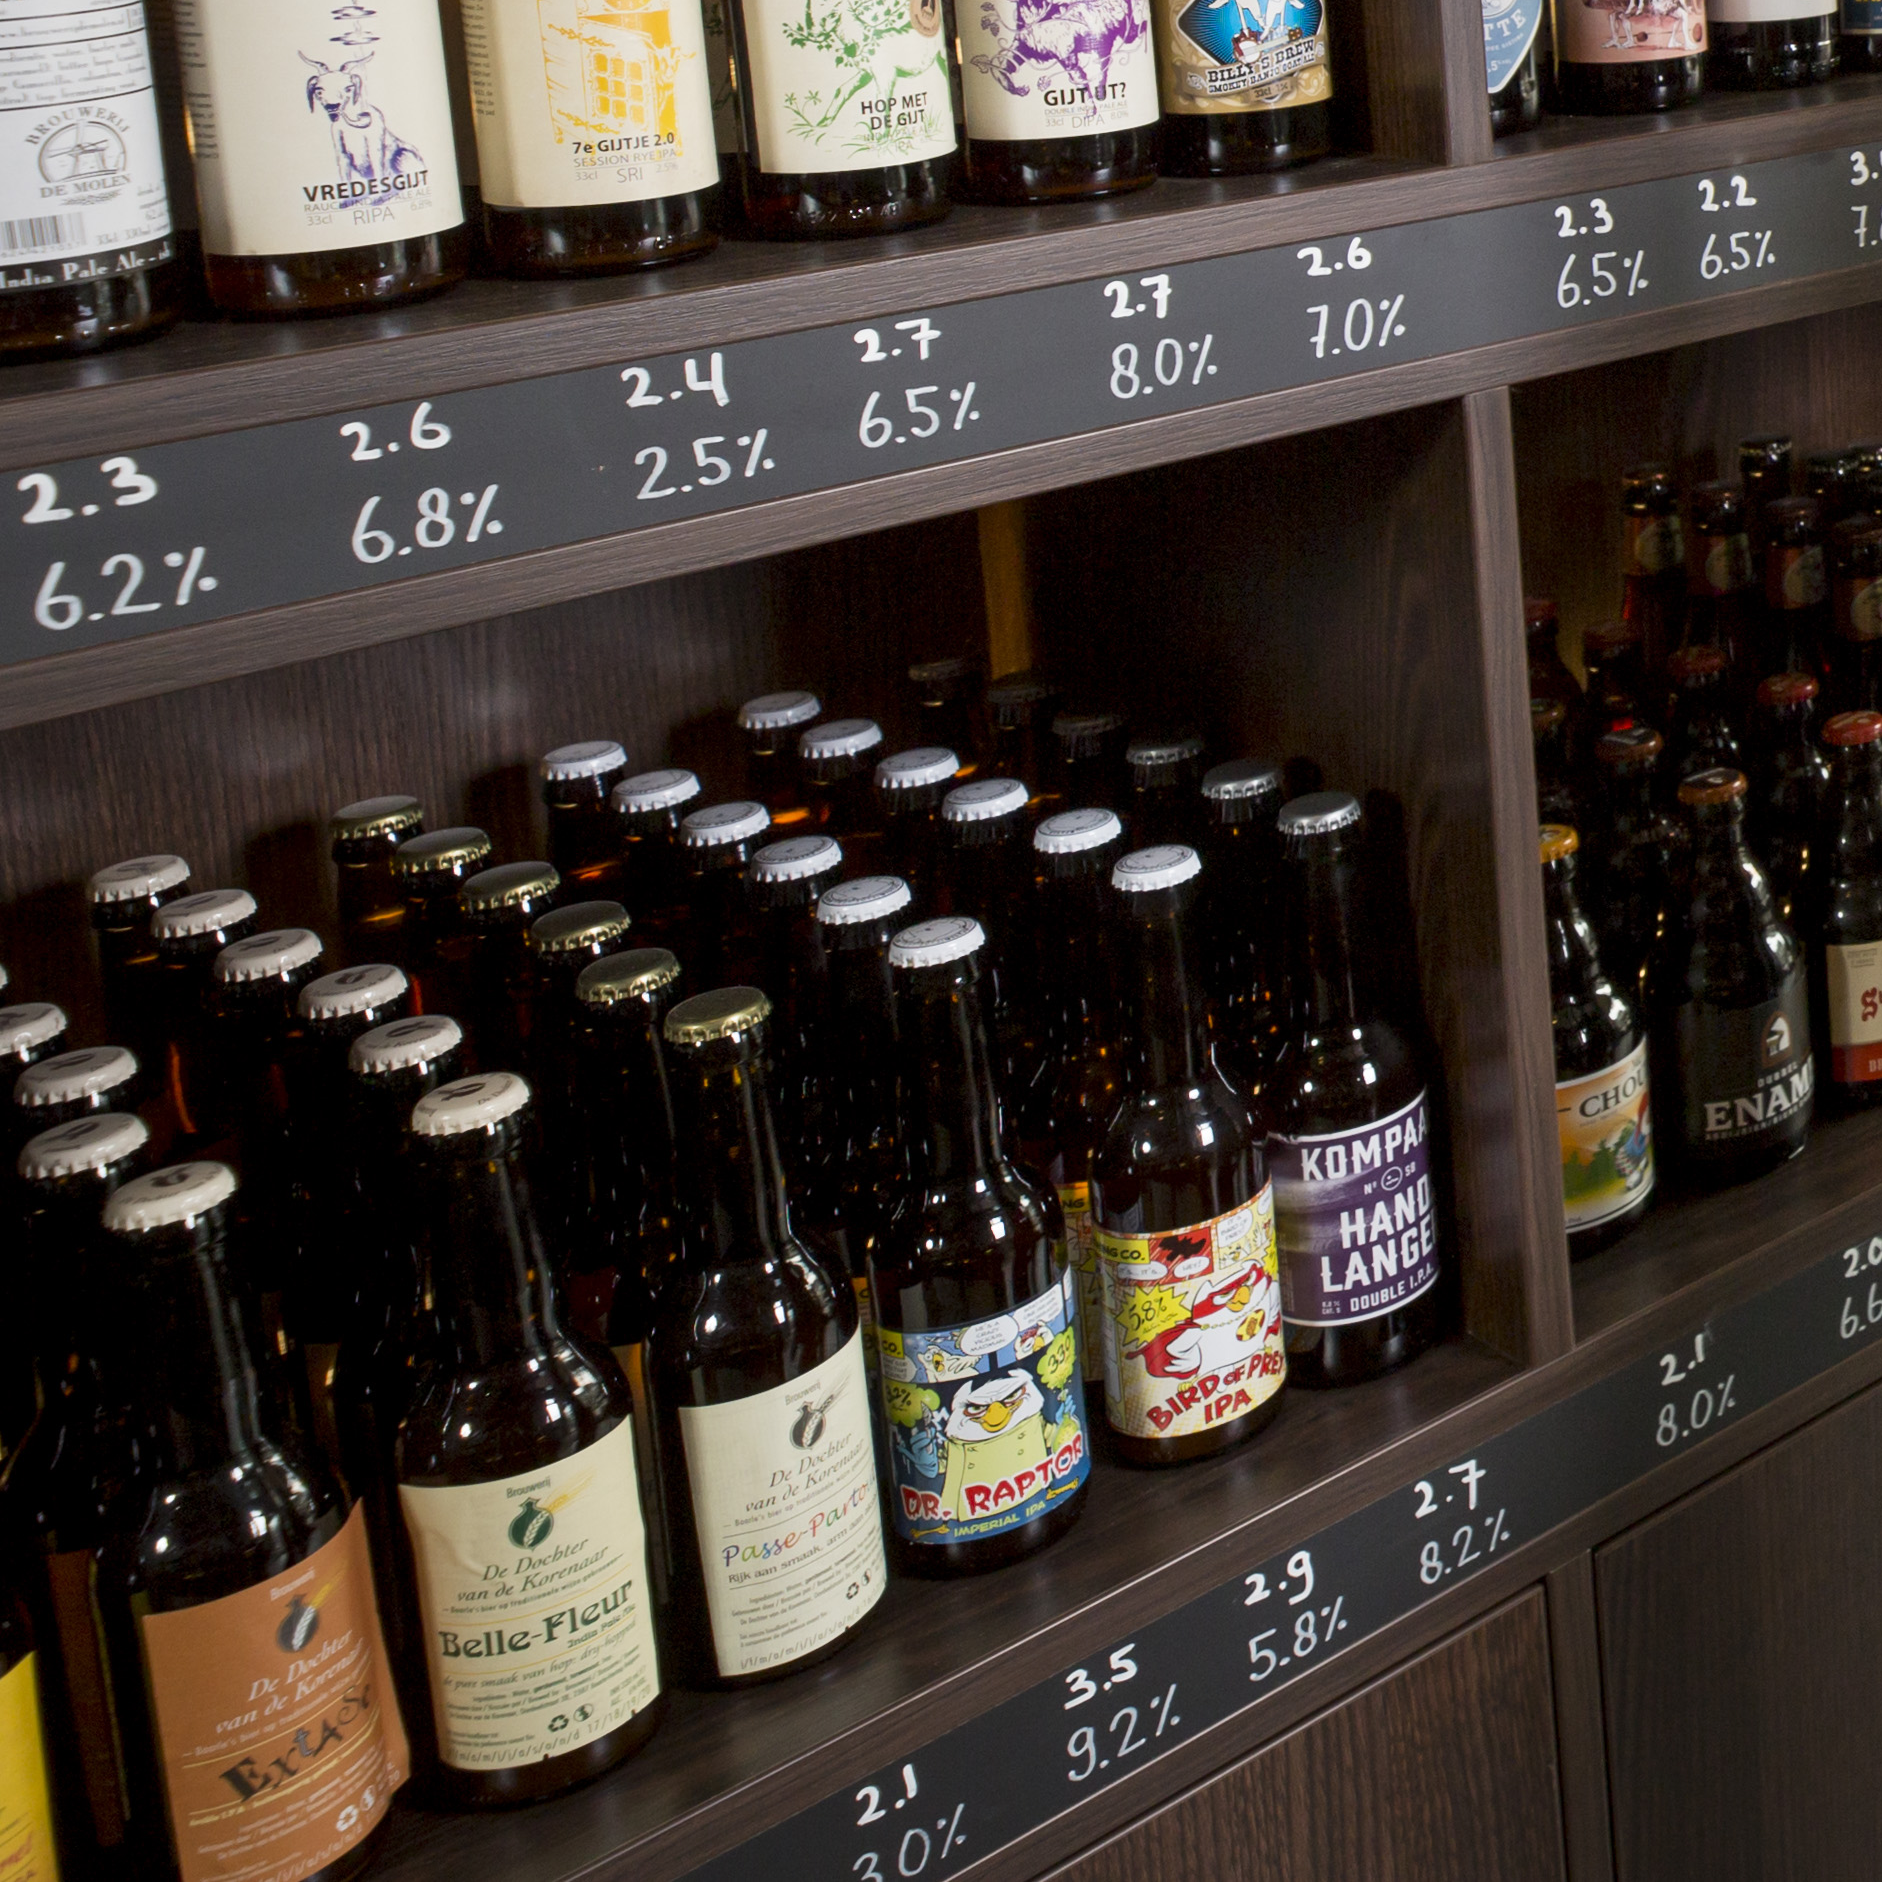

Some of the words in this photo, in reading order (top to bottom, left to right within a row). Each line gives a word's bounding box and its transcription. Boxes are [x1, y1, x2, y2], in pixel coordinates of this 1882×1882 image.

[1274, 38, 1315, 63] BREW
[860, 97, 897, 115] HOP
[902, 92, 928, 108] MET
[870, 113, 892, 130] DE
[897, 109, 926, 126] GIJT
[1043, 88, 1088, 107] GIJT
[1071, 113, 1105, 129] DIPA
[25, 106, 131, 146] BROUWERIJ
[572, 142, 593, 154] 7e
[597, 136, 650, 152] GIJTJE
[654, 132, 675, 146] 2.0
[40, 185, 68, 199] DE
[74, 173, 132, 194] MOLEN
[303, 170, 428, 202] VREDESGIJT
[573, 155, 630, 168] SESSION
[633, 152, 655, 162] RYE
[616, 166, 643, 183] SRI
[353, 206, 395, 225] RIPA
[1554, 198, 1614, 238] 2.3
[1698, 175, 1757, 212] 2.2
[62, 261, 108, 281] Pale
[116, 251, 145, 271] Ale
[1296, 236, 1372, 277] 2.6
[1557, 249, 1649, 309] 6.5%
[1700, 230, 1776, 280] 6.5%
[1103, 273, 1173, 319] 2.7
[853, 317, 942, 363] 2.7
[1306, 294, 1406, 359] 7.0%
[620, 352, 730, 408] 2.4
[1110, 333, 1218, 399] 8.0%
[340, 401, 452, 462] 2.6
[859, 381, 980, 448] 6.5%
[17, 456, 158, 524] 2.3
[634, 428, 775, 500] 2.5%
[352, 483, 503, 564] 6.8%
[34, 546, 218, 631] 6.2%
[1705, 1053, 1815, 1134] ENAM
[1339, 1174, 1431, 1249] HAND
[1349, 1280, 1405, 1313] DOUBLE
[1659, 1333, 1705, 1386] 2.1
[785, 1380, 822, 1406] Brouwerij
[1146, 1372, 1219, 1433] BIRD
[1222, 1361, 1246, 1387] OF
[1247, 1349, 1284, 1381] PREY
[1203, 1388, 1253, 1424] IPA
[1656, 1367, 1736, 1447] 8.0%
[745, 1496, 776, 1513] van
[782, 1482, 800, 1498] de
[805, 1438, 865, 1490] Korenaar
[770, 1469, 791, 1489] De
[799, 1432, 852, 1476] Dochter
[901, 1482, 953, 1522] DR.
[963, 1435, 1084, 1518] RAPTOR
[507, 1477, 552, 1499] Brouwerij
[1413, 1459, 1486, 1519] 2.7
[722, 1472, 877, 1567] Passe-Parto
[953, 1511, 1021, 1538] IMPERIAL
[1024, 1498, 1047, 1518] IPA
[457, 1589, 489, 1602] van
[495, 1580, 513, 1598] de
[521, 1545, 609, 1592] Korenaar
[482, 1564, 508, 1582] De
[514, 1538, 589, 1575] Dochter
[1414, 1502, 1510, 1592] 8.2%
[728, 1571, 752, 1585] Rijk
[754, 1565, 778, 1580] aan
[1244, 1550, 1314, 1606] 2.9
[438, 1579, 633, 1659] Belle-Fleur
[1244, 1589, 1355, 1689] 5.8%
[248, 1677, 278, 1702] De
[285, 1630, 352, 1685] Dochter
[1064, 1643, 1138, 1710] 3.5
[216, 1709, 258, 1734] van
[265, 1693, 288, 1715] de
[1064, 1677, 1187, 1789] 9.2%
[855, 1763, 918, 1826] 2.1
